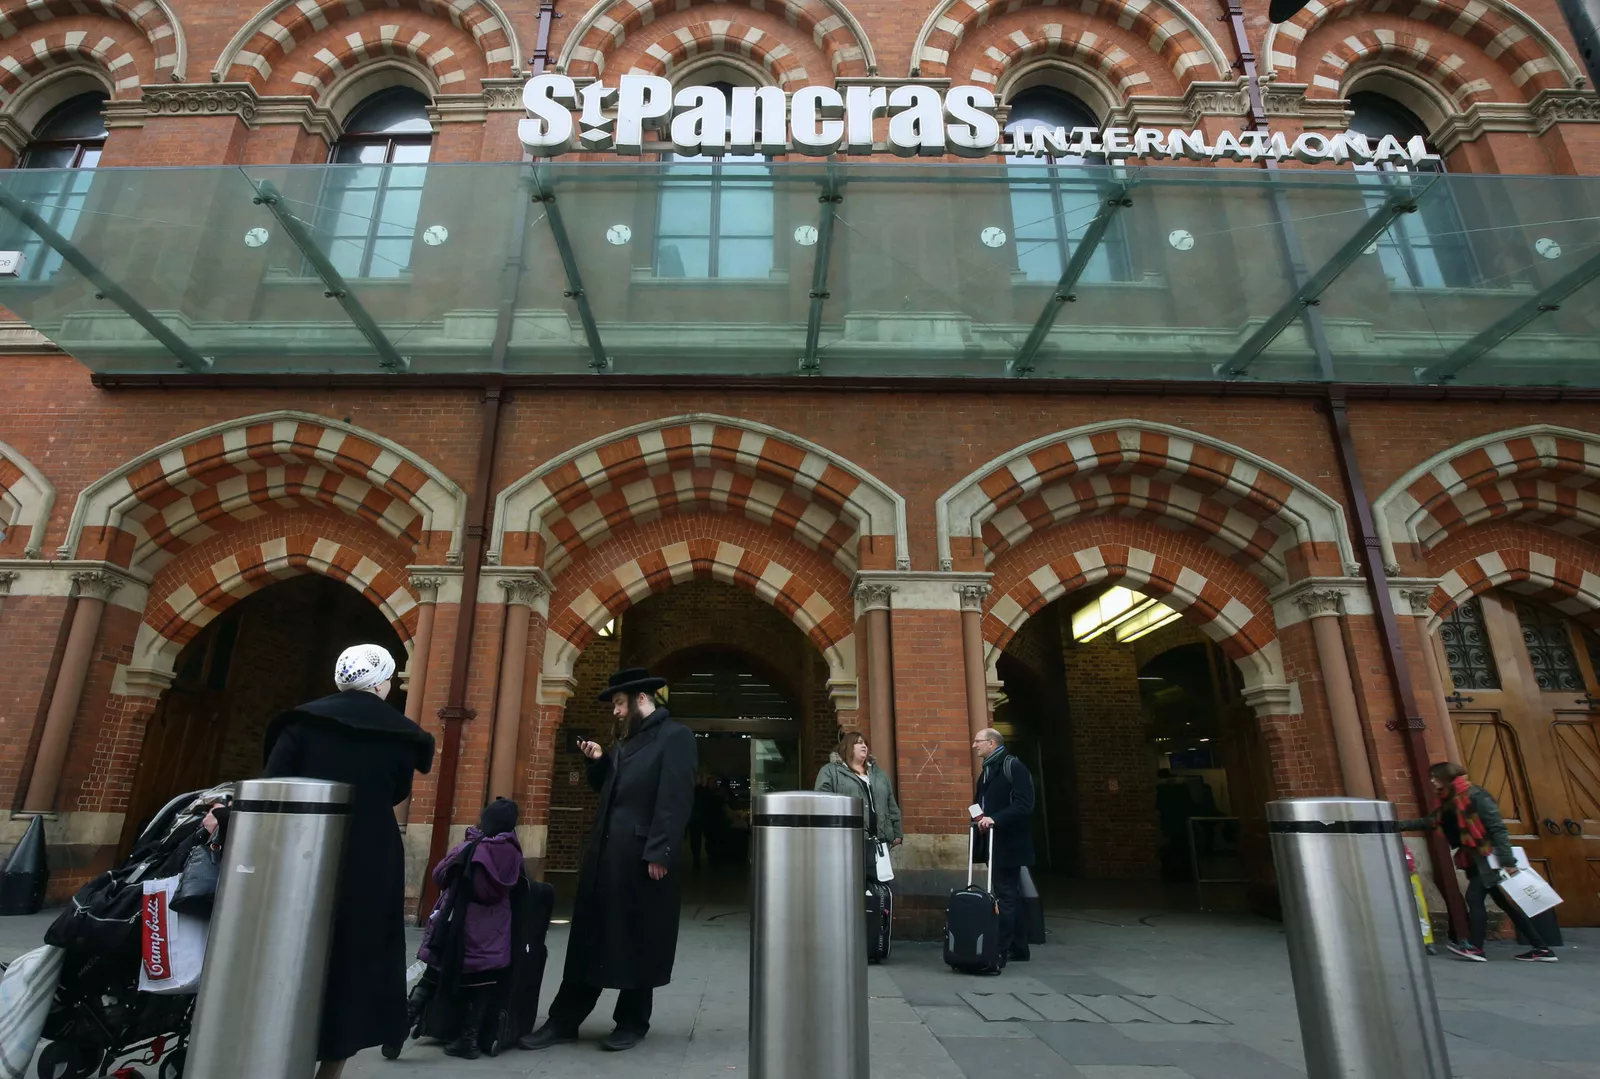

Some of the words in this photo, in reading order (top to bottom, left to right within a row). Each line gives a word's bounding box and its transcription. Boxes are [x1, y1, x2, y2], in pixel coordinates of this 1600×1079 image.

[517, 74, 619, 155] St
[615, 74, 1001, 157] Pancras
[1012, 125, 1441, 168] INTERNATIONAL
